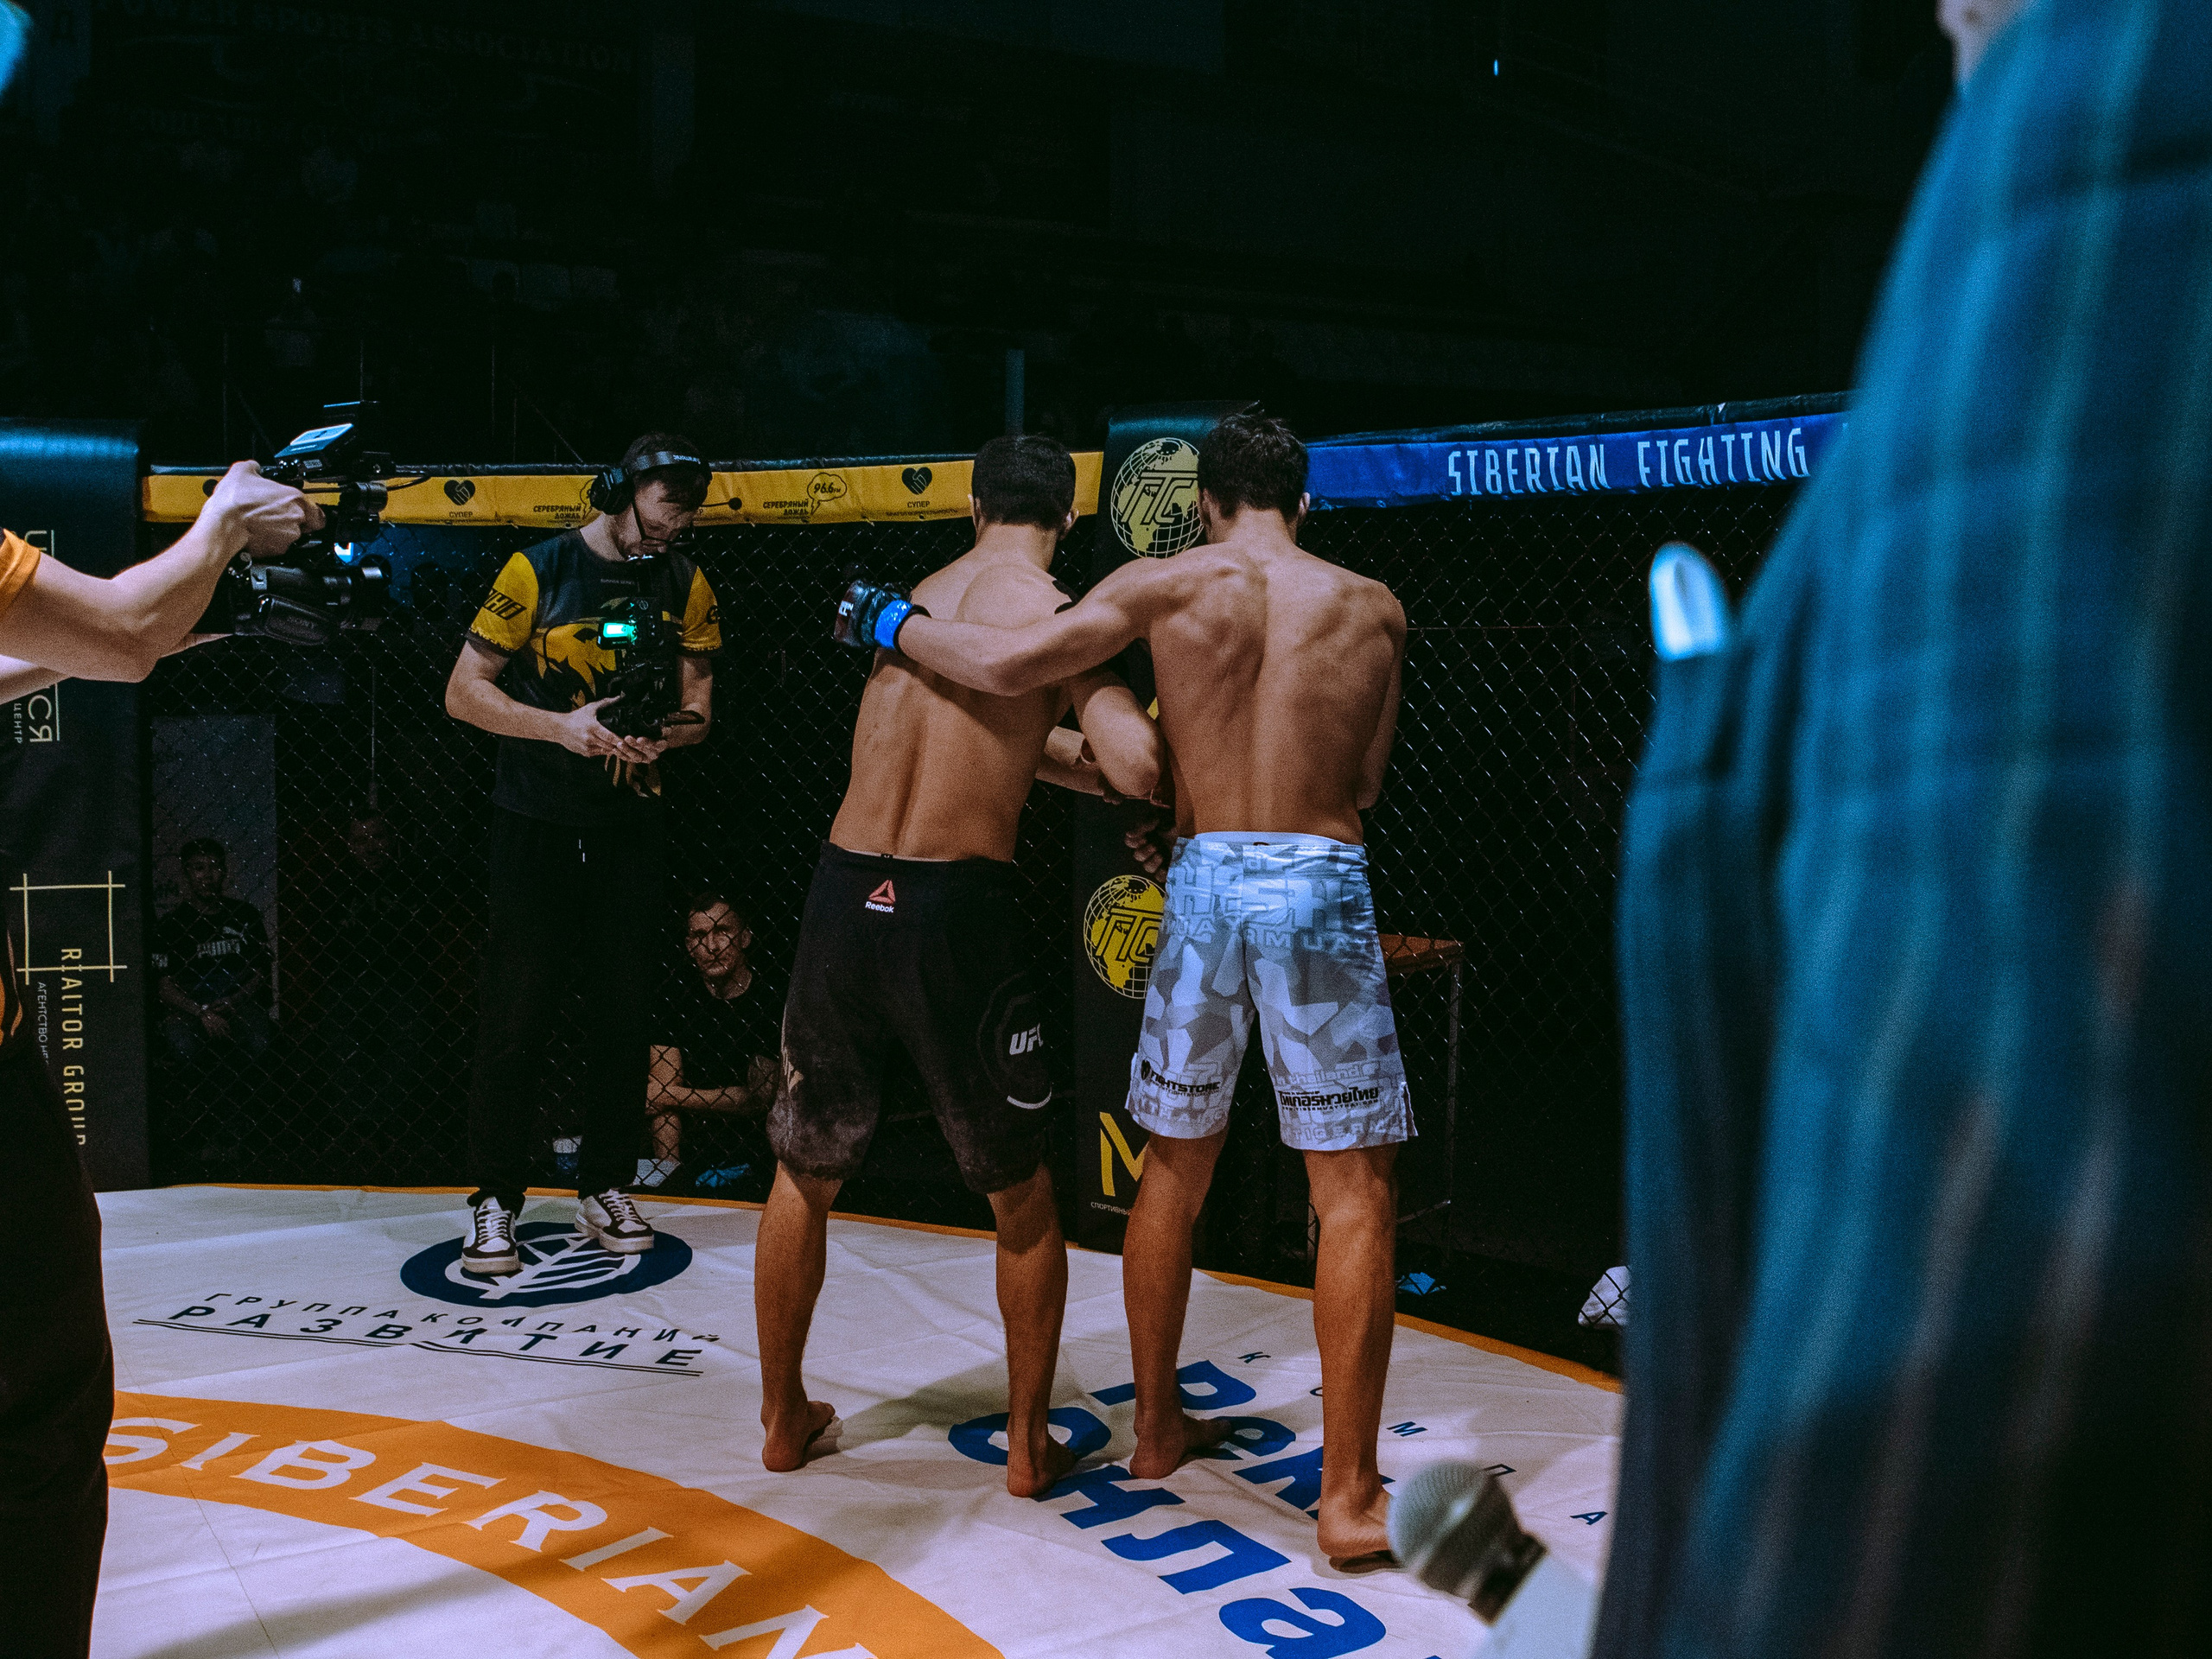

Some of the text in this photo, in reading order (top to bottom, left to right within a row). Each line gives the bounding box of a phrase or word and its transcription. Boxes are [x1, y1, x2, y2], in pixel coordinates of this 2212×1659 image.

[1447, 427, 1810, 497] SIBERIAN FIGHTING
[763, 499, 809, 509] СЕРЕБРЯНЫЙ
[14, 703, 23, 745] ЦЕНТР
[865, 900, 895, 913] Reebok
[37, 982, 49, 1044] АГЕНТСТВО
[204, 1293, 399, 1319] ГРУППА
[168, 1305, 703, 1367] РАЗВИТИЕ
[103, 1416, 878, 1659] SIBERIAN
